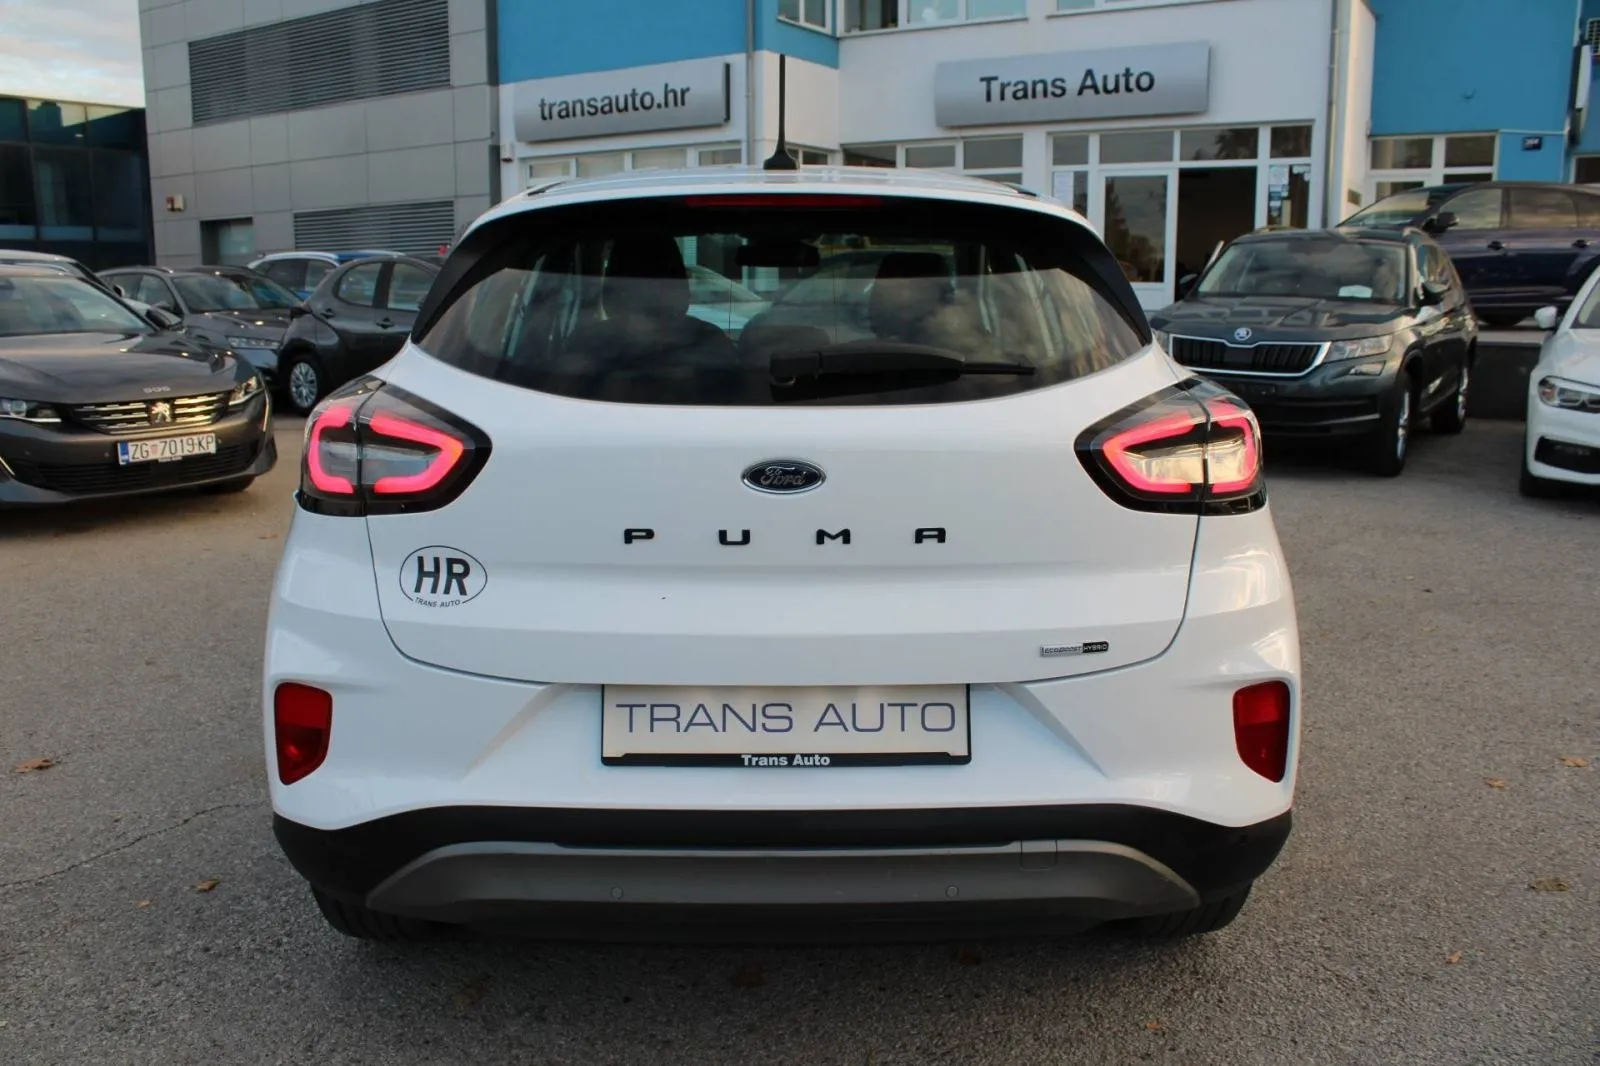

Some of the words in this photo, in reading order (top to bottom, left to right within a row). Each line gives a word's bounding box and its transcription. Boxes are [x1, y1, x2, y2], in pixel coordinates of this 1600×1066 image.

[979, 76, 1067, 102] Trans
[1077, 67, 1155, 96] Auto
[539, 82, 691, 121] transauto.hr
[131, 442, 150, 460] ZG
[760, 465, 807, 487] Ford
[624, 528, 947, 545] PUMA
[414, 555, 470, 596] HR
[415, 597, 438, 608] TRANS
[439, 599, 461, 608] AUTO
[1083, 644, 1108, 652] HYBRID
[616, 703, 793, 733] TRANS
[813, 702, 956, 732] AUTO
[741, 754, 788, 766] Trans
[793, 754, 830, 766] Auto
